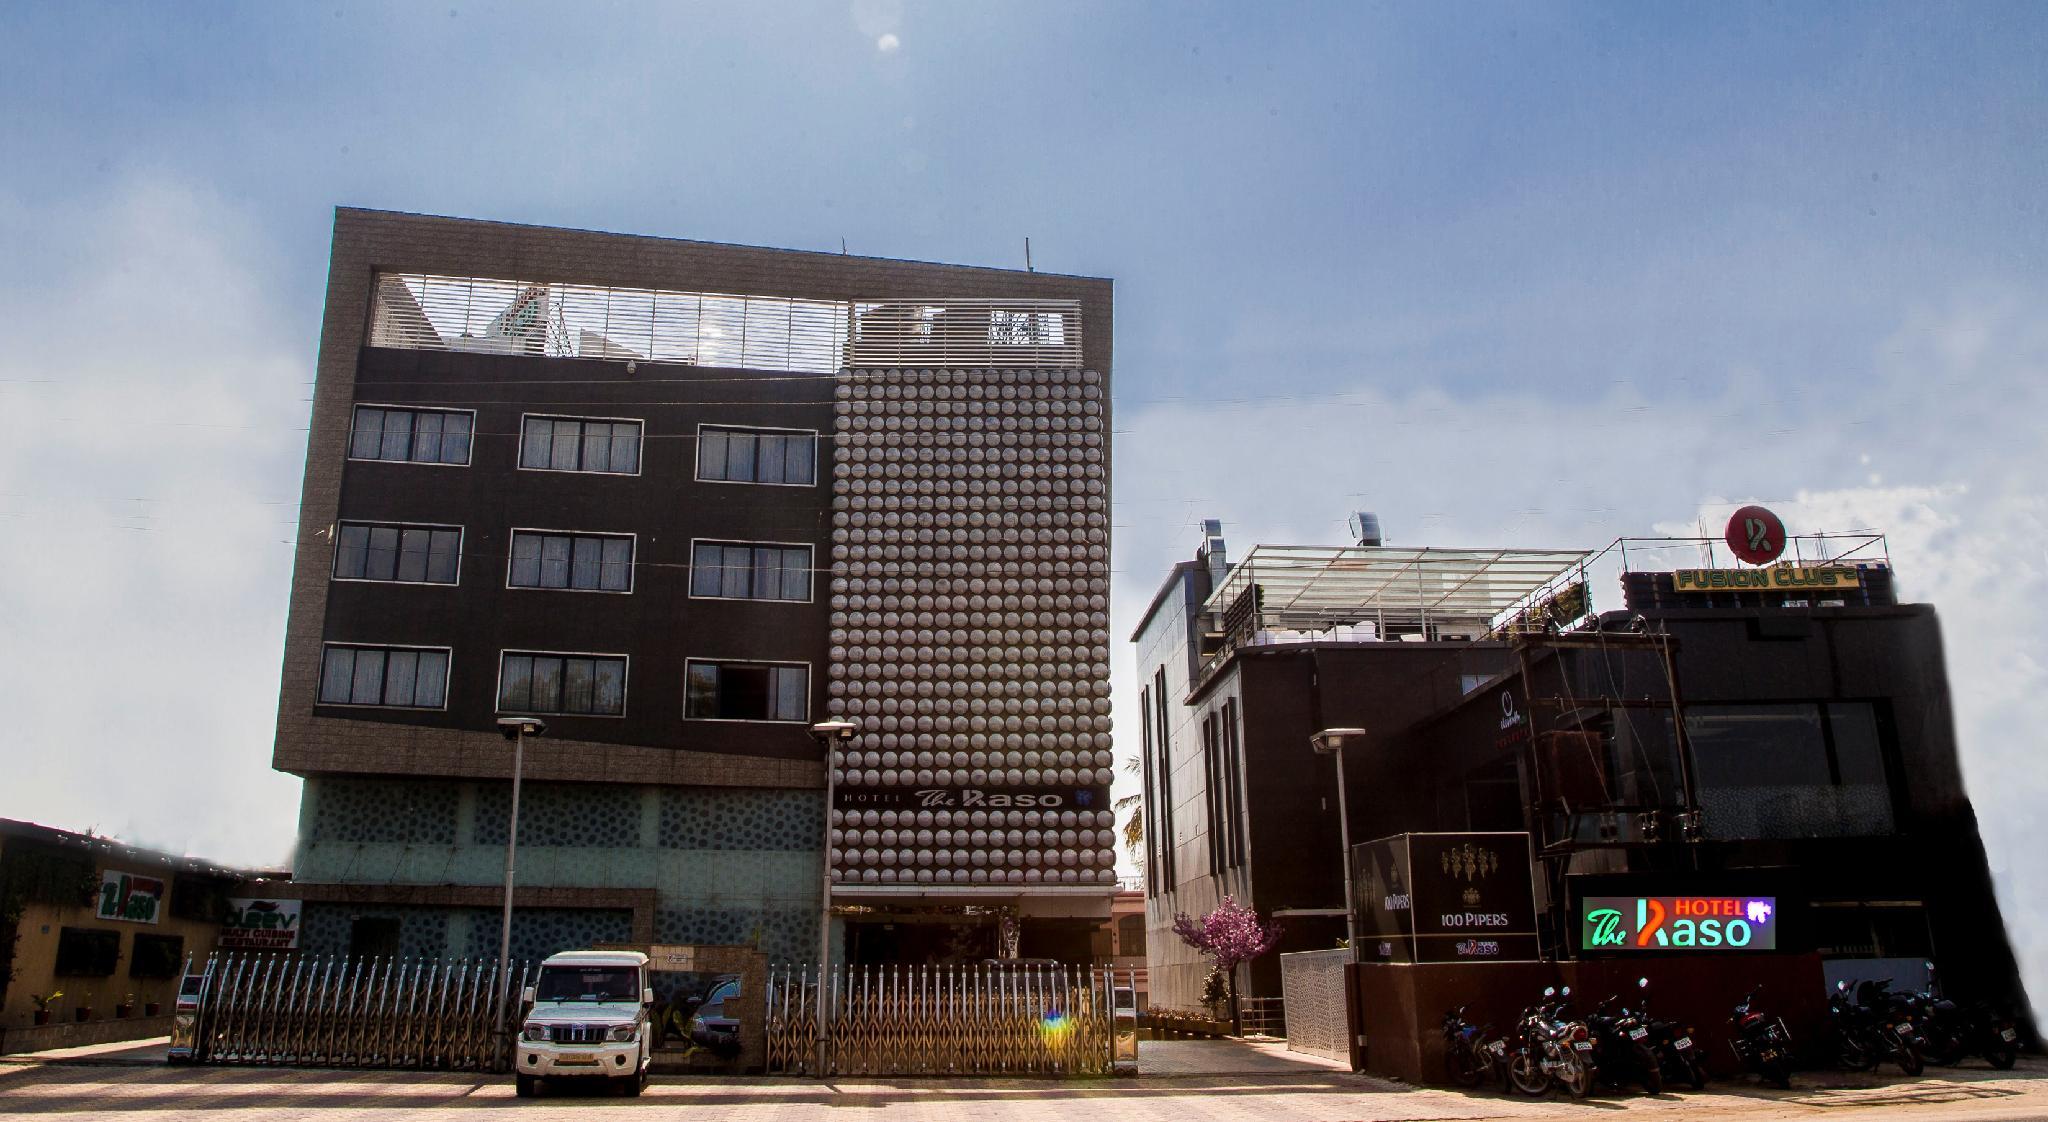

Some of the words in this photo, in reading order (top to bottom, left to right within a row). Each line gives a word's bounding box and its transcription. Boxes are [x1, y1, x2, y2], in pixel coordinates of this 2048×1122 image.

[1679, 568, 1769, 588] FUSION
[844, 794, 900, 802] HOTEL
[915, 789, 955, 807] The
[962, 789, 1063, 807] Raso
[1675, 899, 1745, 916] HOTEL
[1441, 914, 1464, 927] 100
[1465, 912, 1509, 926] PIPERS
[1587, 909, 1626, 946] The
[1637, 899, 1752, 947] Raso
[221, 928, 250, 938] MULTI
[254, 929, 296, 939] CUISINE
[223, 938, 291, 947] RESTAURANT
[1468, 938, 1500, 955] Raso
